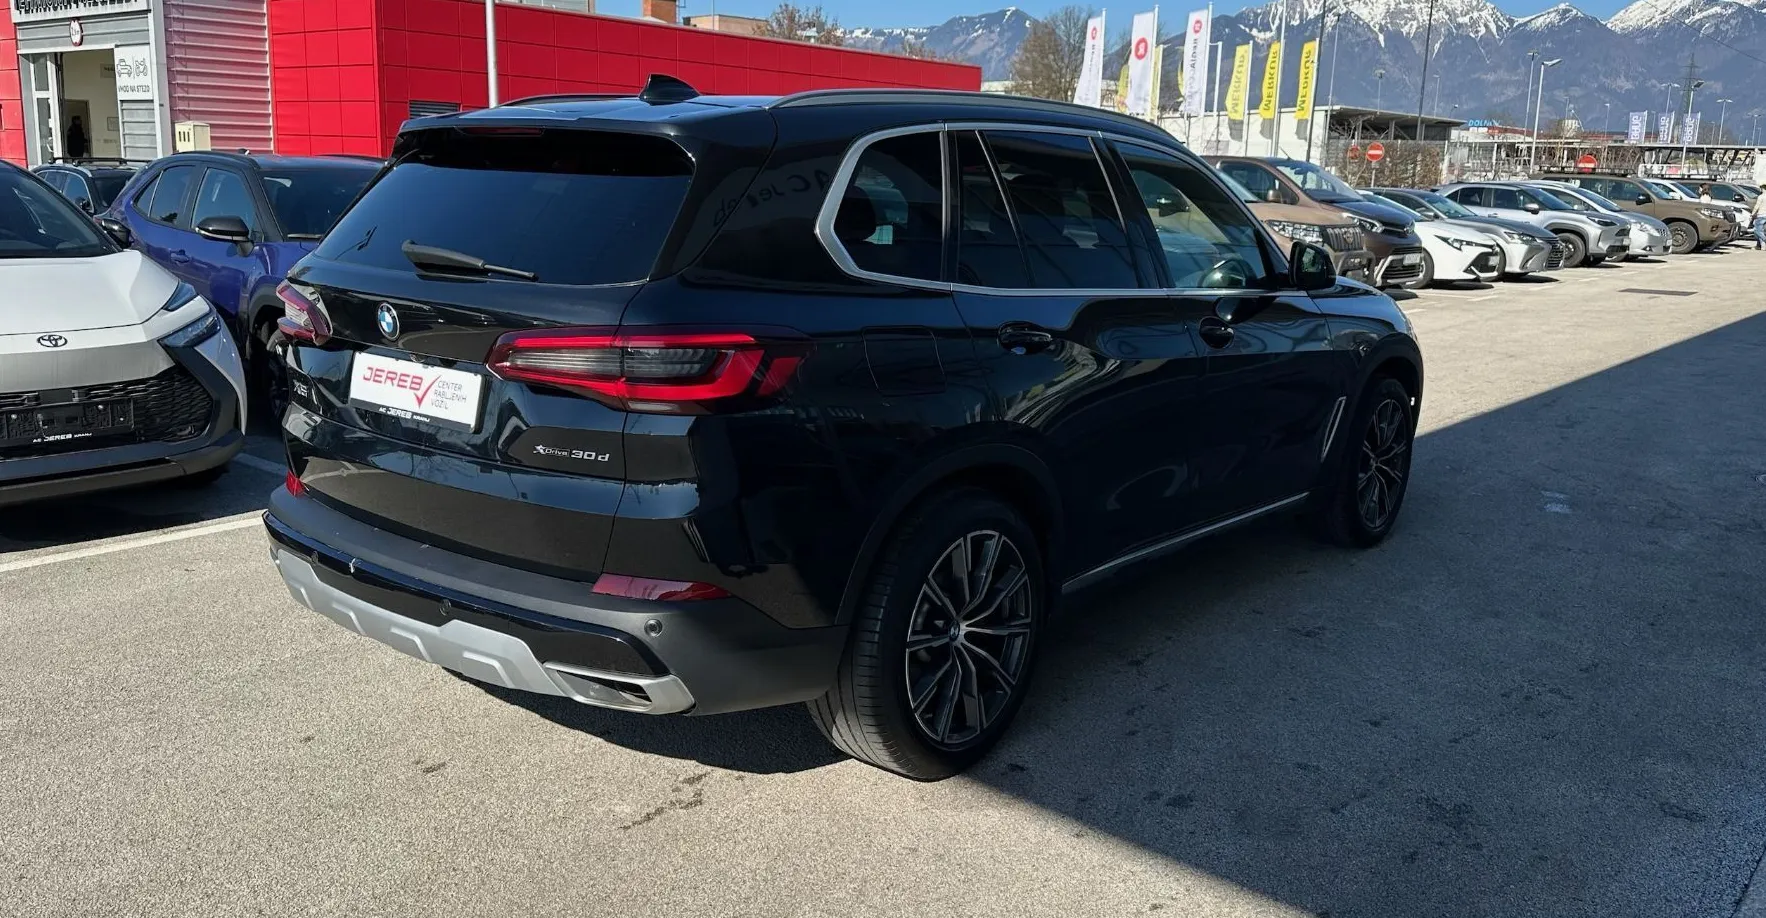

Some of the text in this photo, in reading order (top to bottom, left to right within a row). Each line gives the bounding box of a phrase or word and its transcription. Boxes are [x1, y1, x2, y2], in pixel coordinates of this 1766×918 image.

[363, 366, 424, 391] JEREB
[293, 379, 309, 398] X5
[438, 380, 463, 392] CENTER
[434, 389, 467, 403] RABLJENIH
[430, 398, 449, 410] VOZIL
[387, 407, 413, 419] JEREB
[43, 433, 73, 442] JEREB
